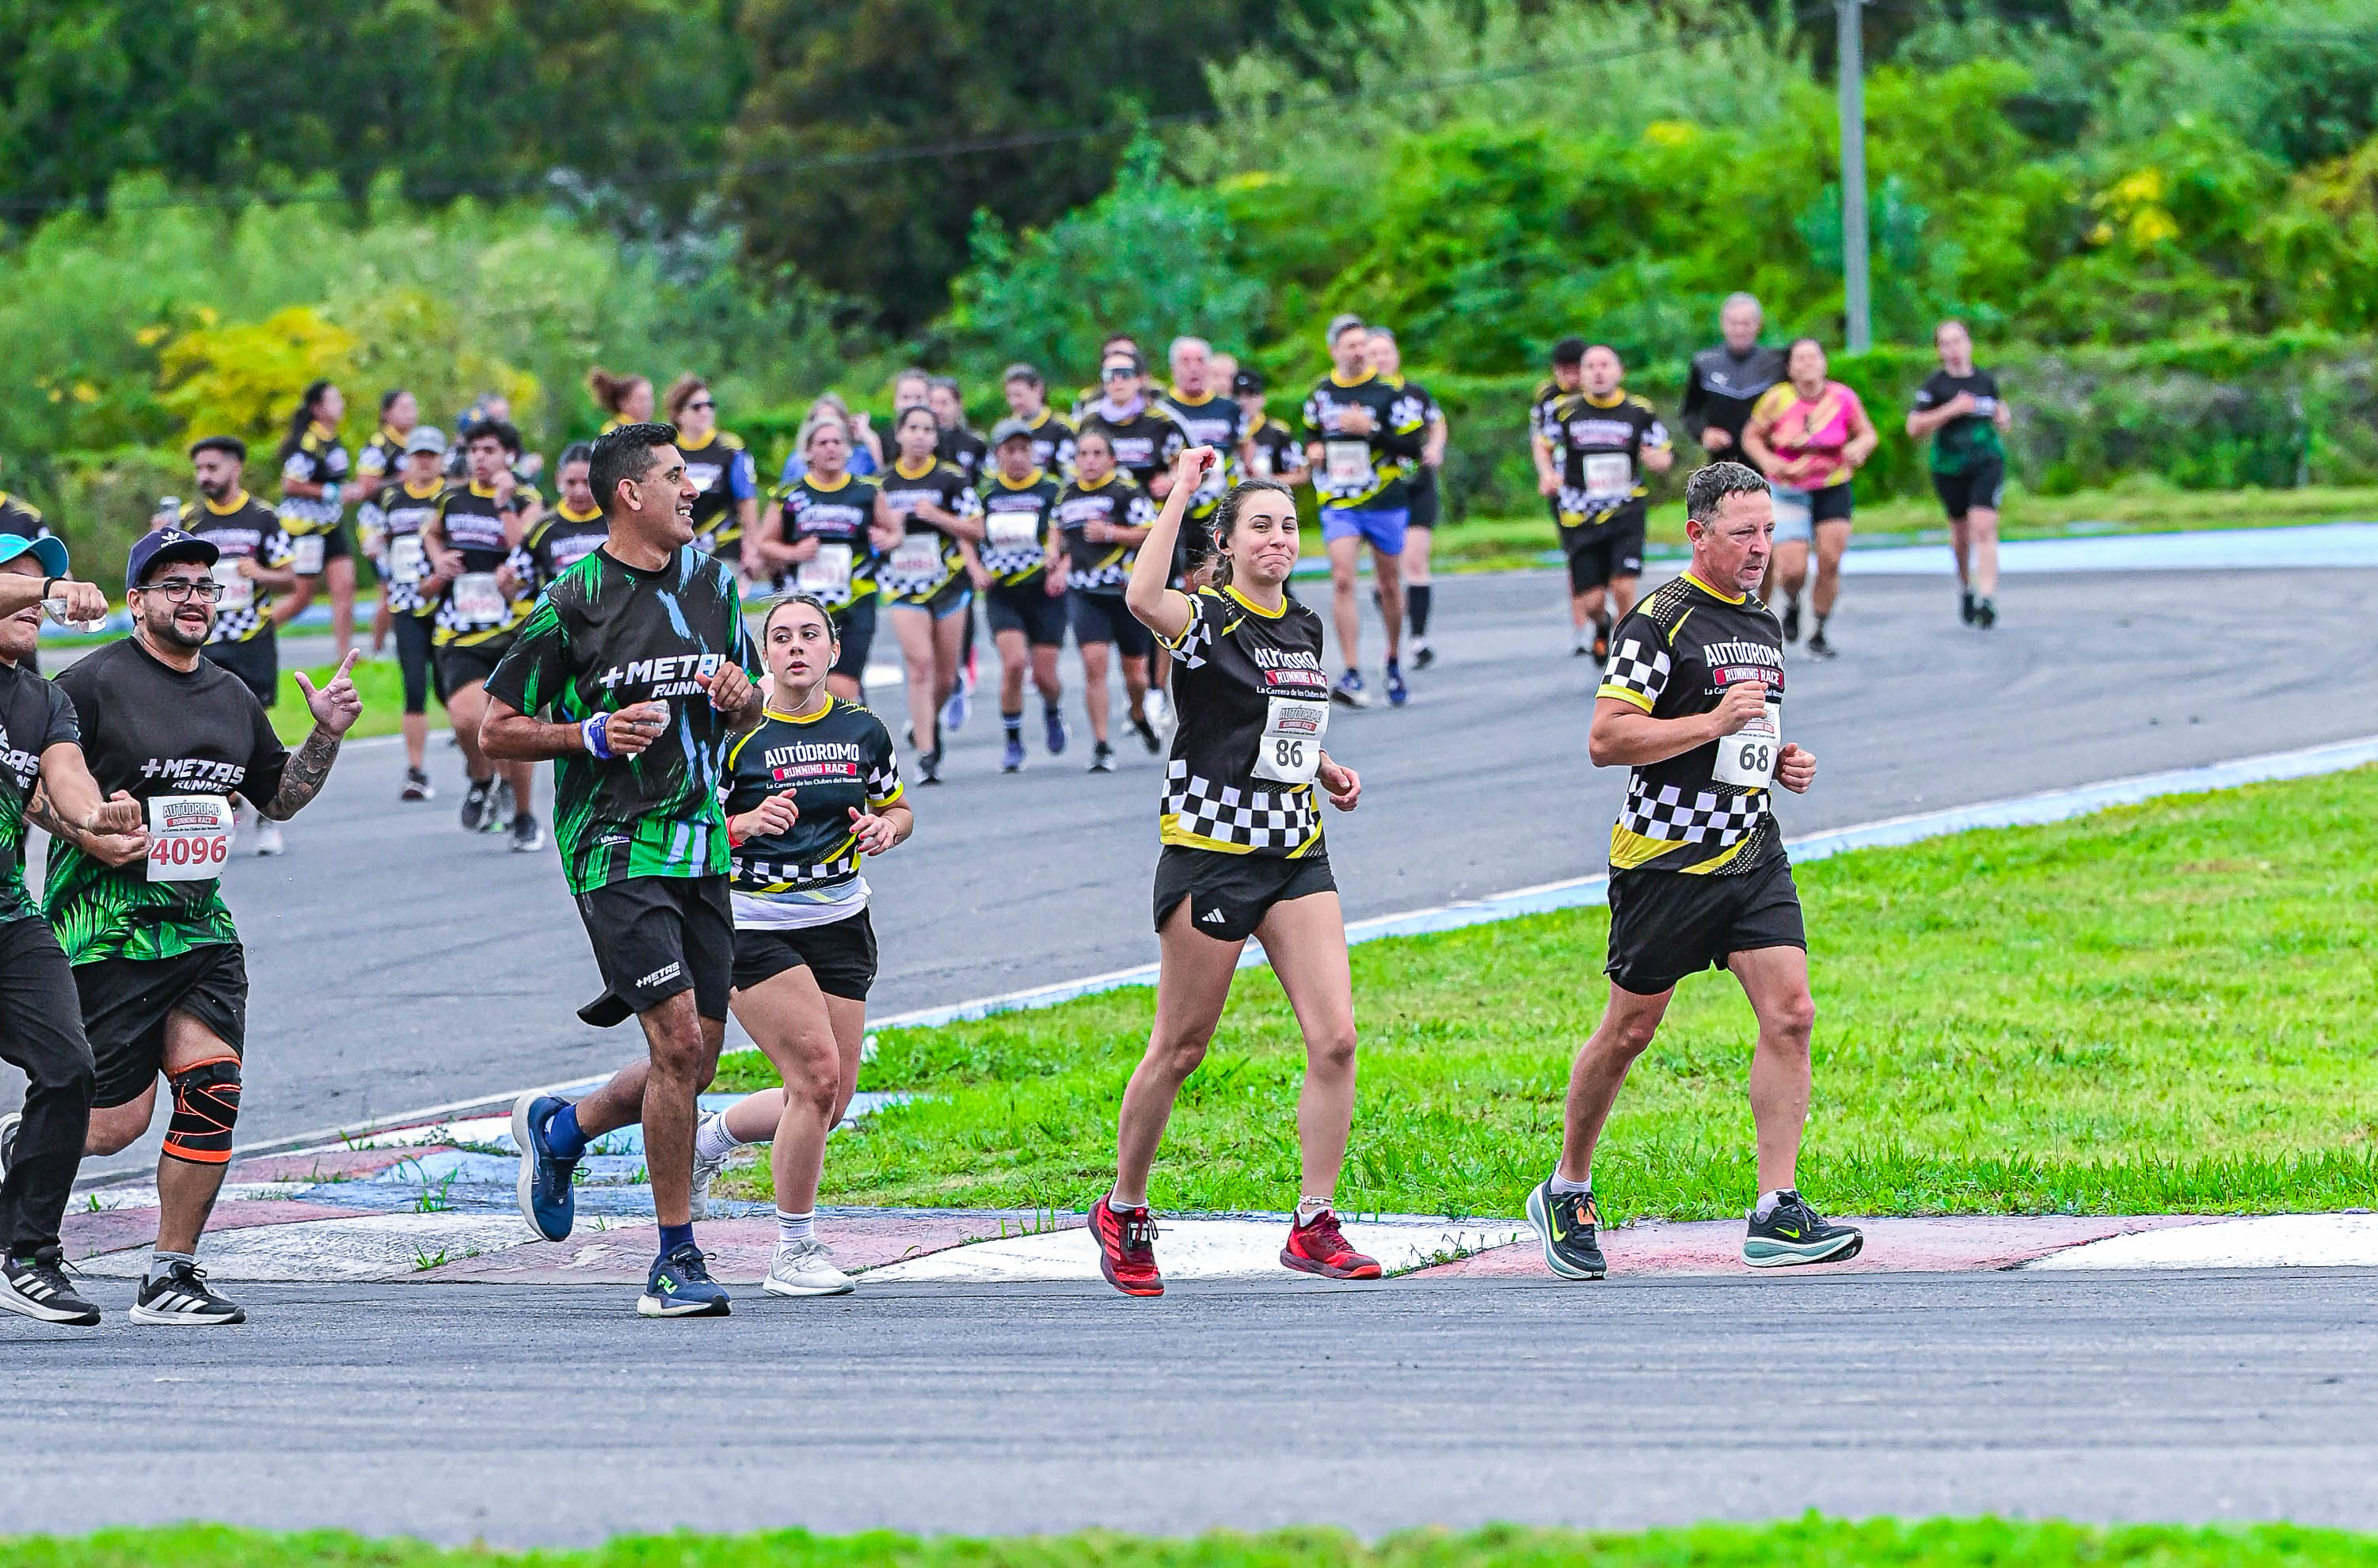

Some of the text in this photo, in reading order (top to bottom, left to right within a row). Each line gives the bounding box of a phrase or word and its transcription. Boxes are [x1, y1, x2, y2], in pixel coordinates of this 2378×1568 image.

[599, 653, 726, 689] +META
[1254, 647, 1322, 673] AUTÓDRO
[1275, 671, 1310, 684] RUNNING
[1724, 668, 1780, 685] RUNNING RACE
[651, 680, 703, 698] RUNN
[1256, 685, 1265, 694] La
[1266, 687, 1289, 695] Carrera
[764, 740, 860, 768] AUTÓDROMO
[1276, 739, 1303, 767] 86
[1740, 744, 1768, 772] 68
[782, 763, 848, 778] RUNNING RACE
[163, 800, 221, 818] AUTÓDROMO
[150, 835, 226, 865] 4096
